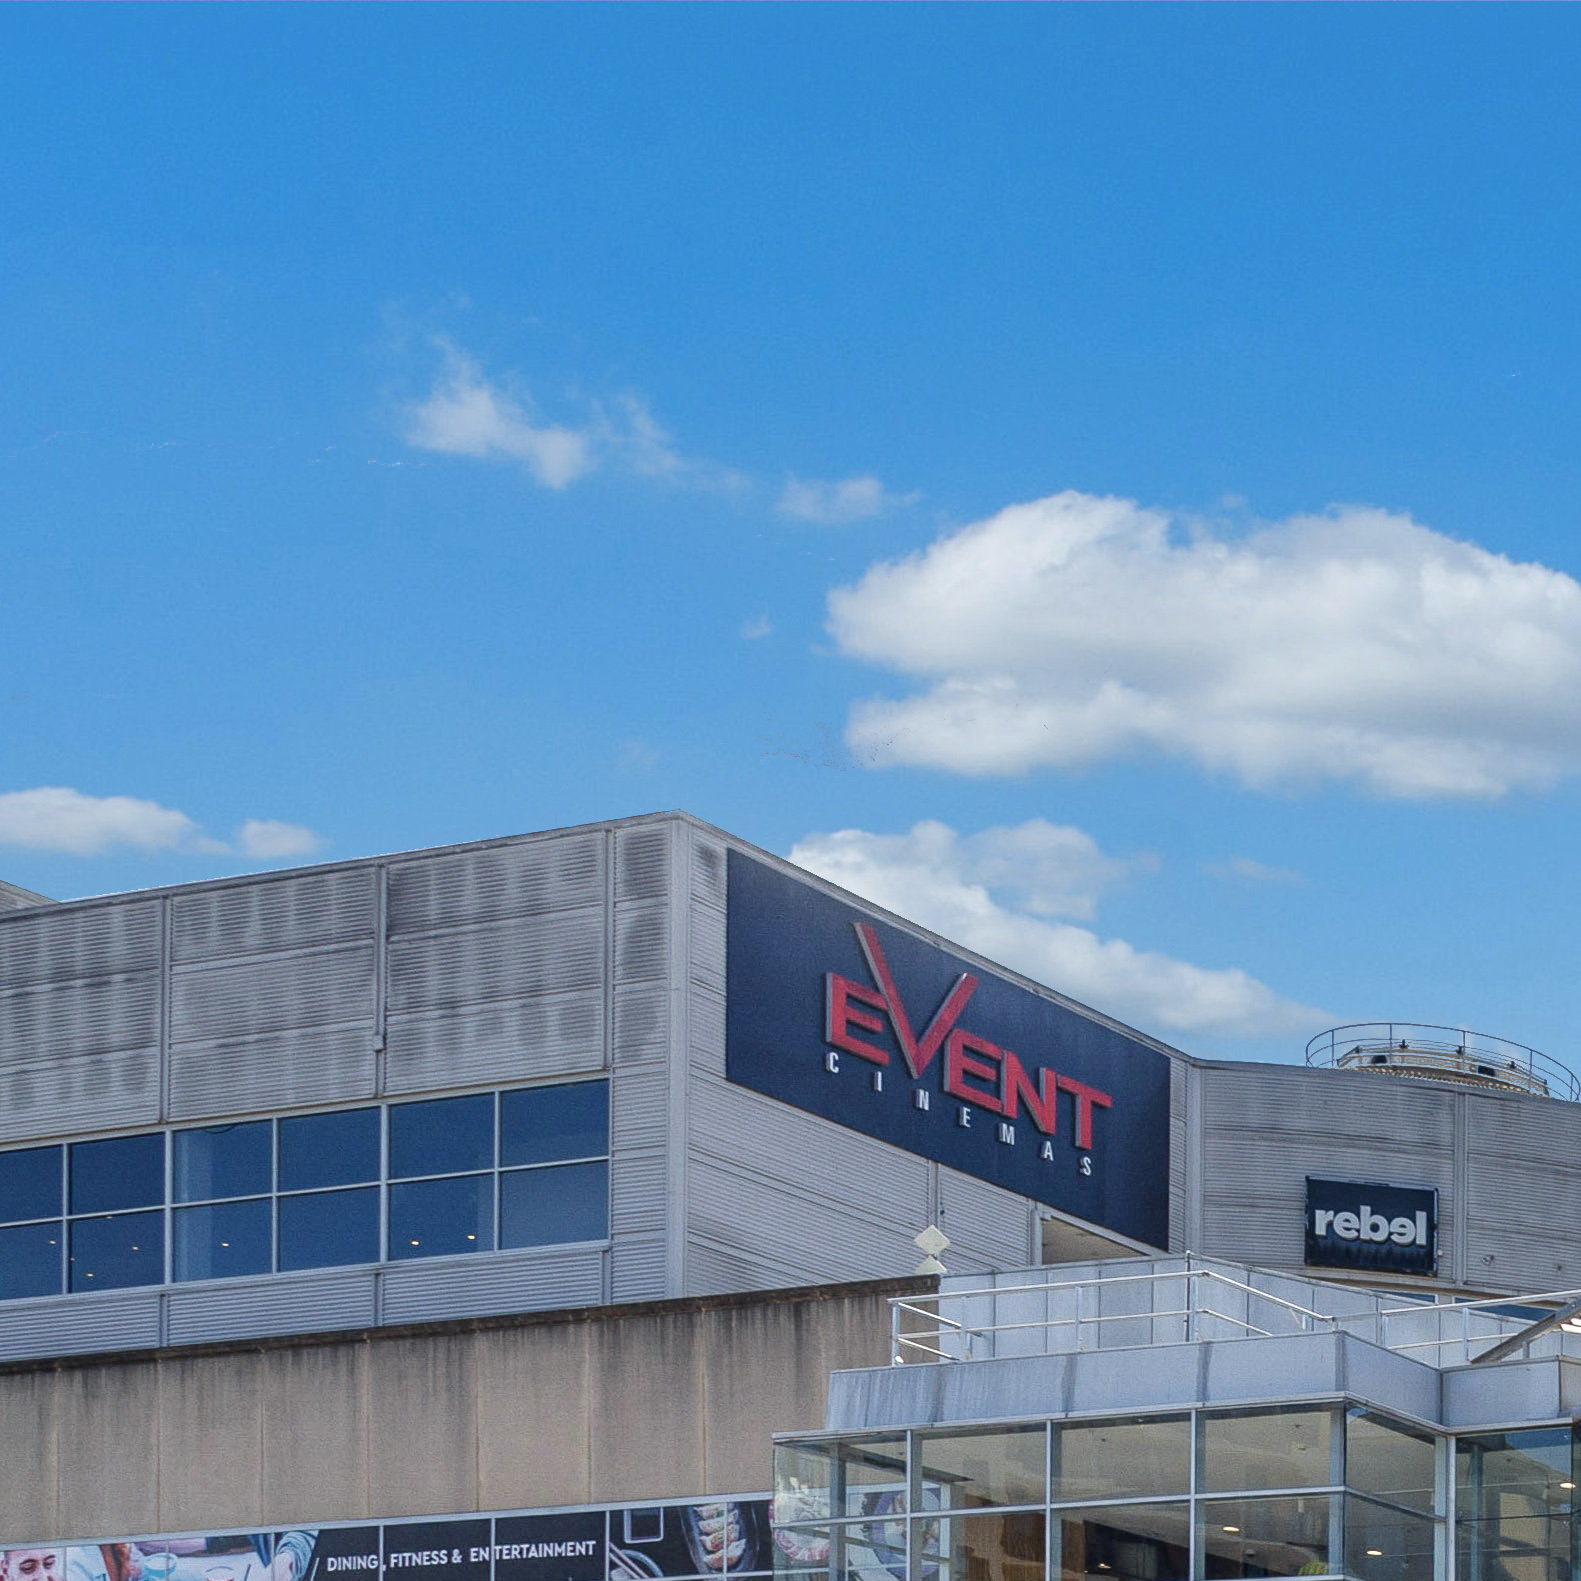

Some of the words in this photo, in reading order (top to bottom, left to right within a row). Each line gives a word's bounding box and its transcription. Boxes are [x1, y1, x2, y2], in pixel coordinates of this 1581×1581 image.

[825, 921, 1112, 1150] EVENT
[825, 1051, 1092, 1178] CINEMAS
[1314, 1205, 1427, 1249] rebel
[390, 1549, 448, 1568] FITNESS
[452, 1549, 463, 1563] &
[470, 1541, 597, 1562] ENTERTAINMENT
